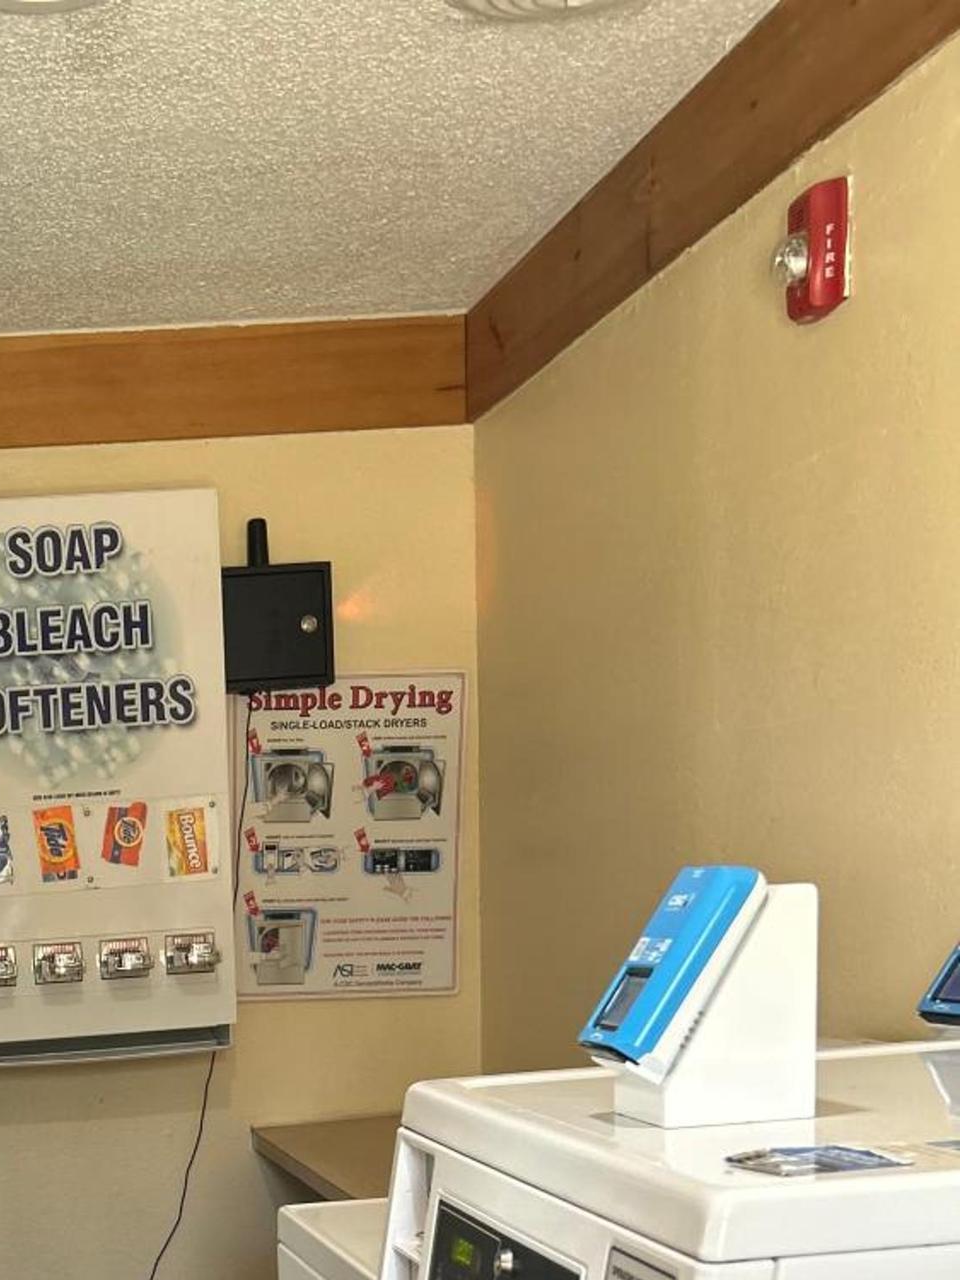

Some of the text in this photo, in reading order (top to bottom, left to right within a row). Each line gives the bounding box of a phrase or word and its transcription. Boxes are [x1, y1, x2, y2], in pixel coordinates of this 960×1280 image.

[825, 223, 836, 278] FIRE
[6, 525, 121, 576] SOAP
[248, 684, 454, 717] Simple Drying
[384, 718, 428, 729] DRYERS
[41, 821, 68, 858] Tide
[120, 819, 138, 845] Tide
[178, 813, 203, 869] Bounce
